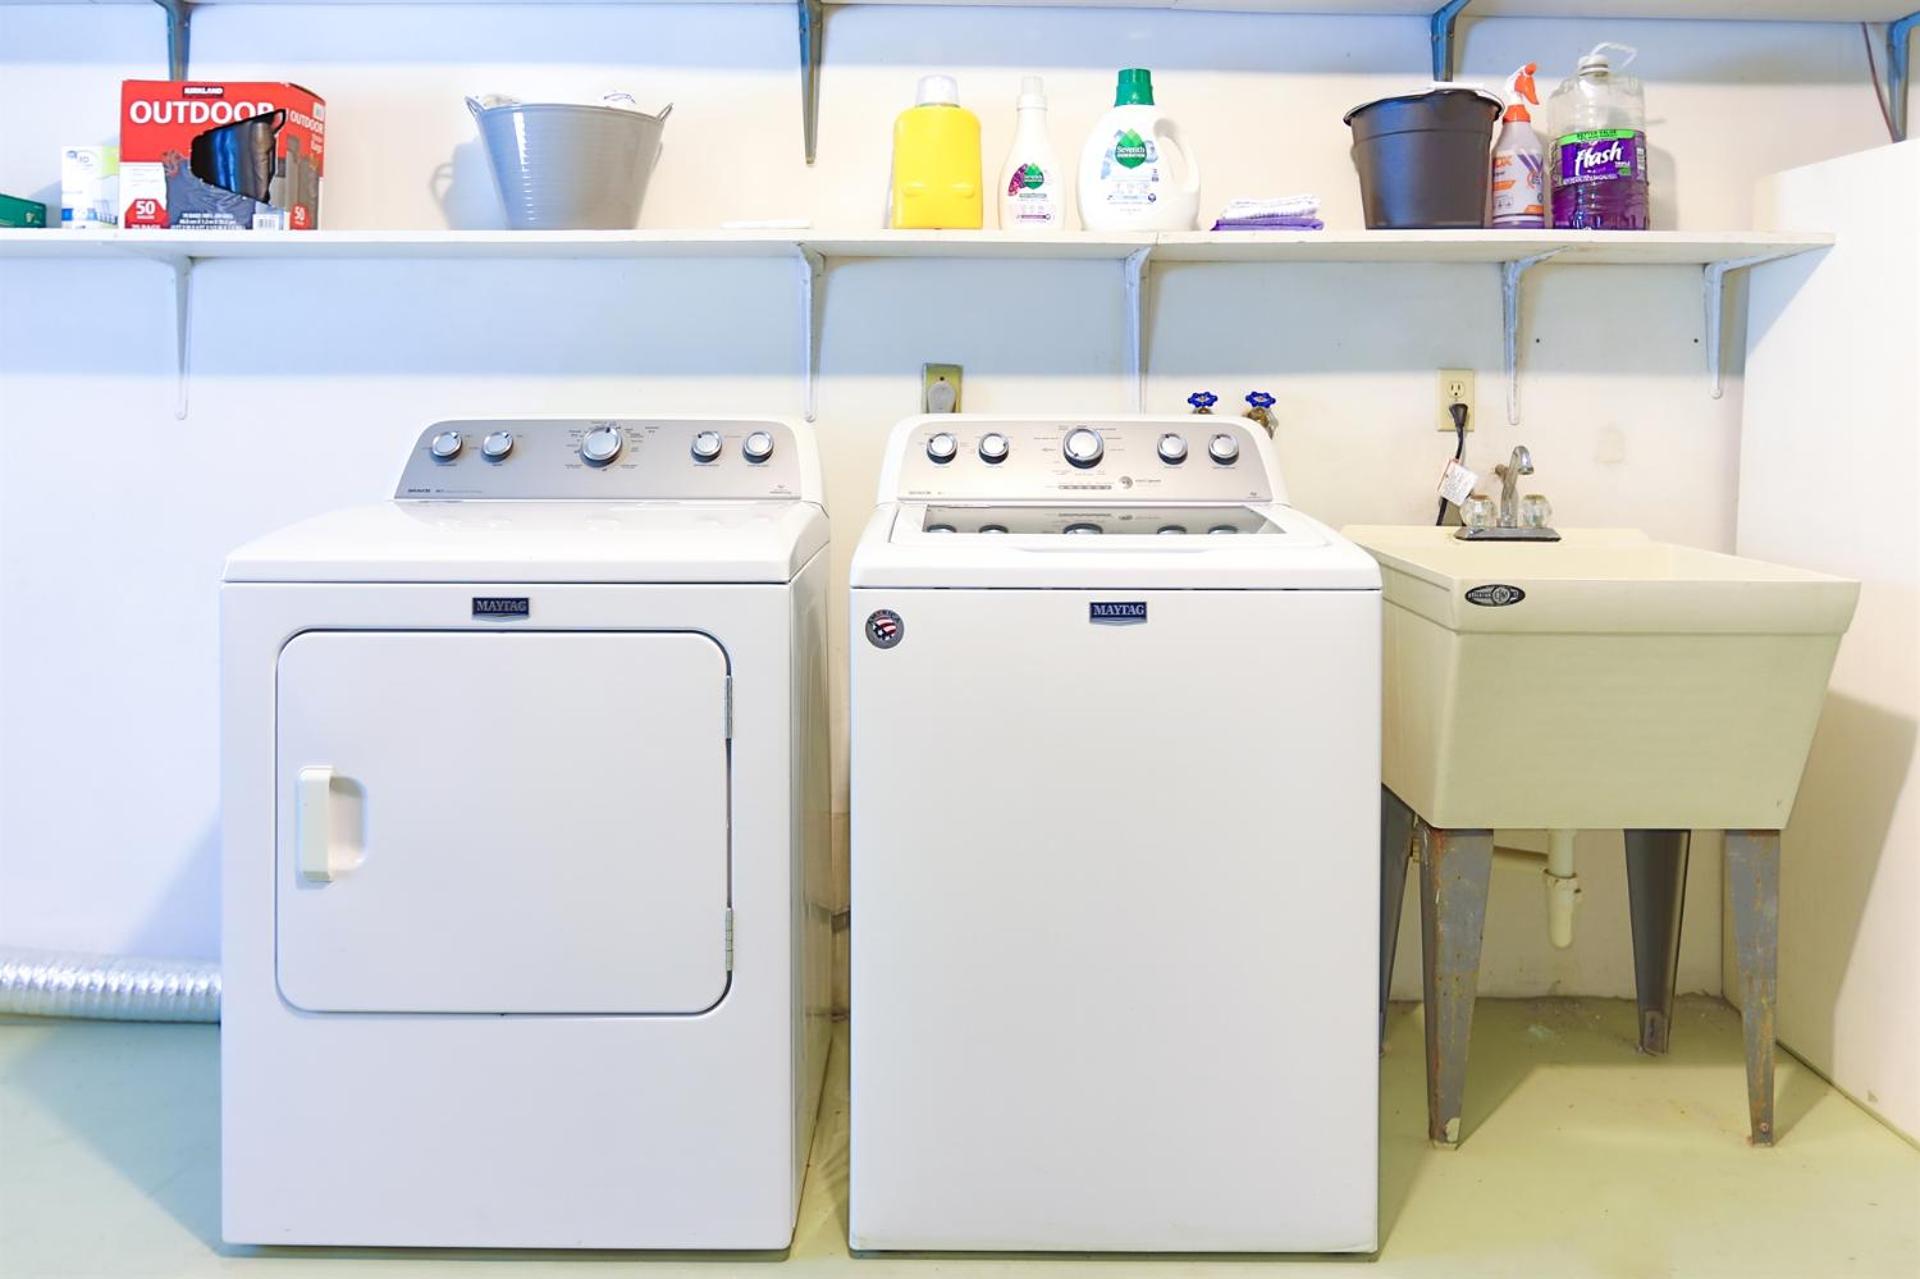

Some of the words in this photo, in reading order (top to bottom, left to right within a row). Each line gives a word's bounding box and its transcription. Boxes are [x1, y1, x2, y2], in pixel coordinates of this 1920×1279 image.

[136, 200, 156, 215] 50
[294, 205, 306, 220] 50
[476, 600, 527, 611] MAYTAG
[1093, 604, 1145, 615] MAYTAG
